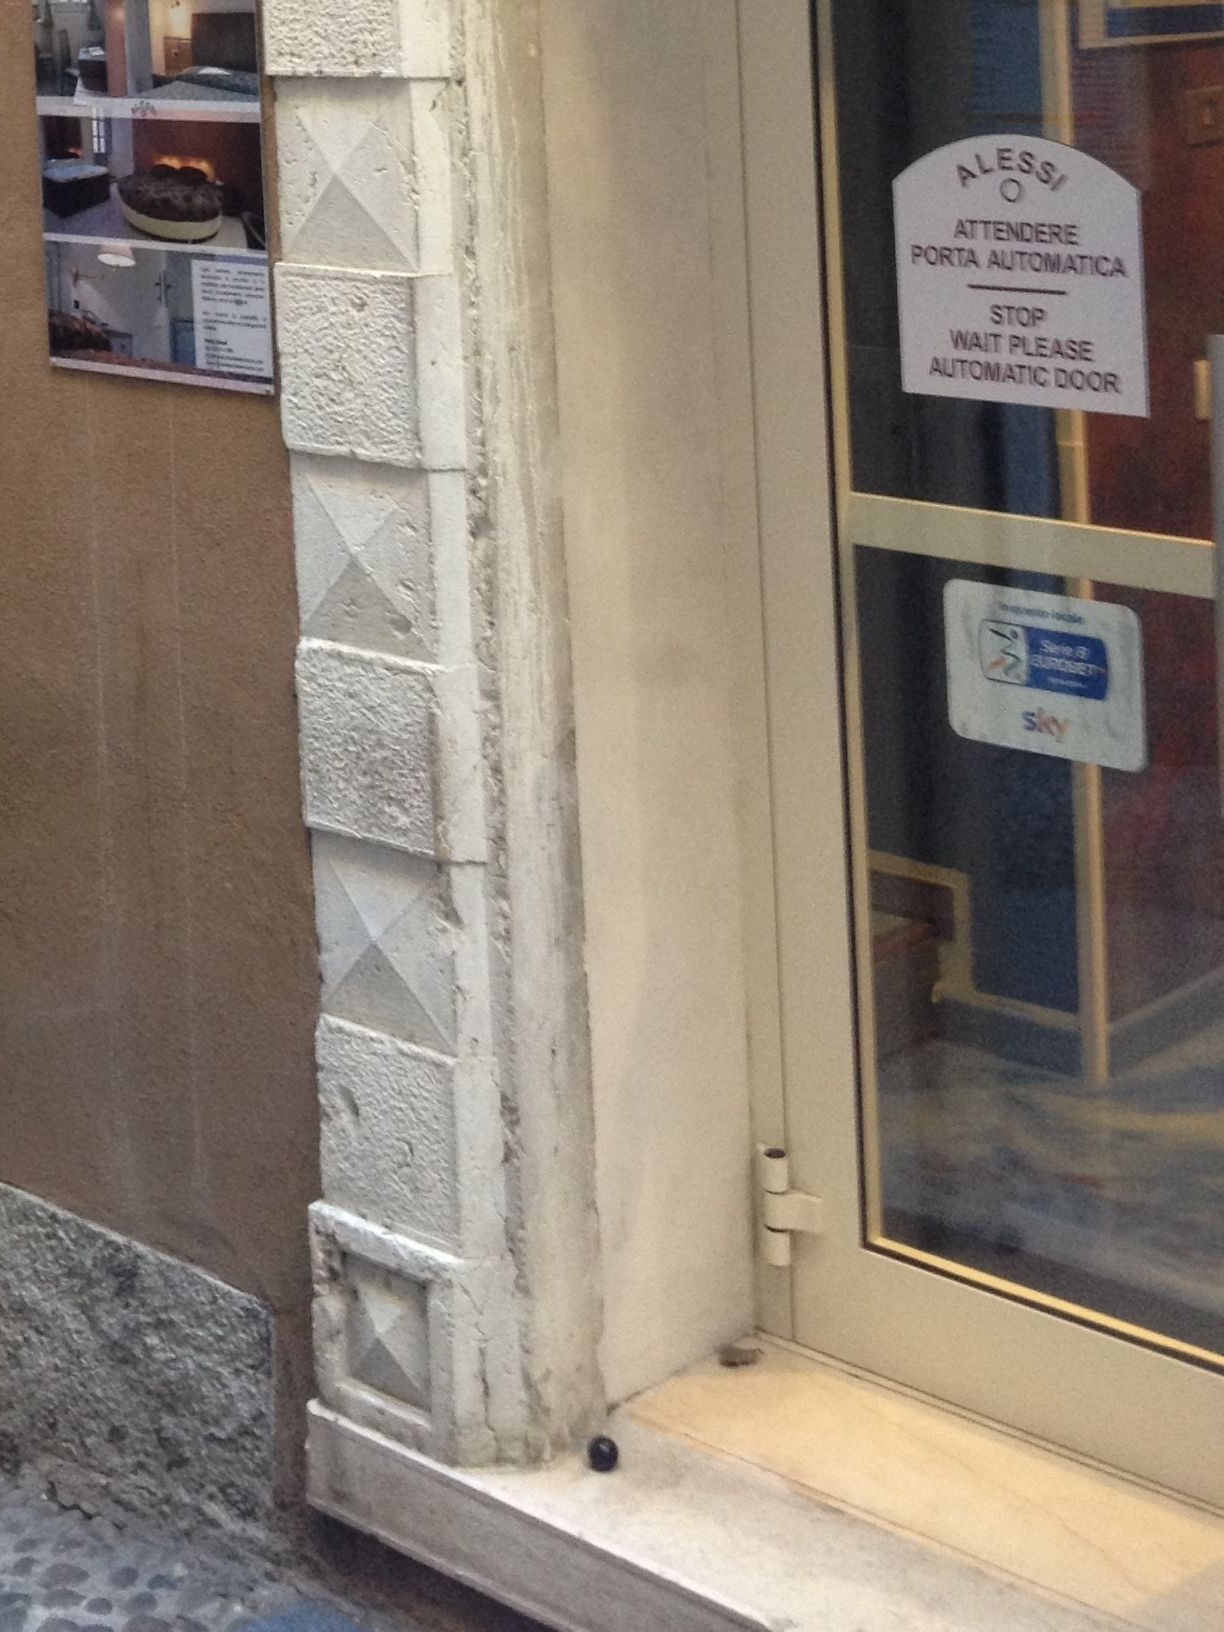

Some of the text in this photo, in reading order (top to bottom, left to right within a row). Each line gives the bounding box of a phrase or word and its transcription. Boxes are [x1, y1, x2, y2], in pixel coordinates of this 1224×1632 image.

[956, 147, 1069, 192] ALESSI
[953, 219, 1079, 245] ATTENDERE
[910, 244, 1128, 278] PORTA AUTOMATICA
[990, 304, 1047, 327] STOP
[949, 329, 1095, 361] WAIT PLEASE
[929, 356, 1121, 394] AUTOMATIC DOOR
